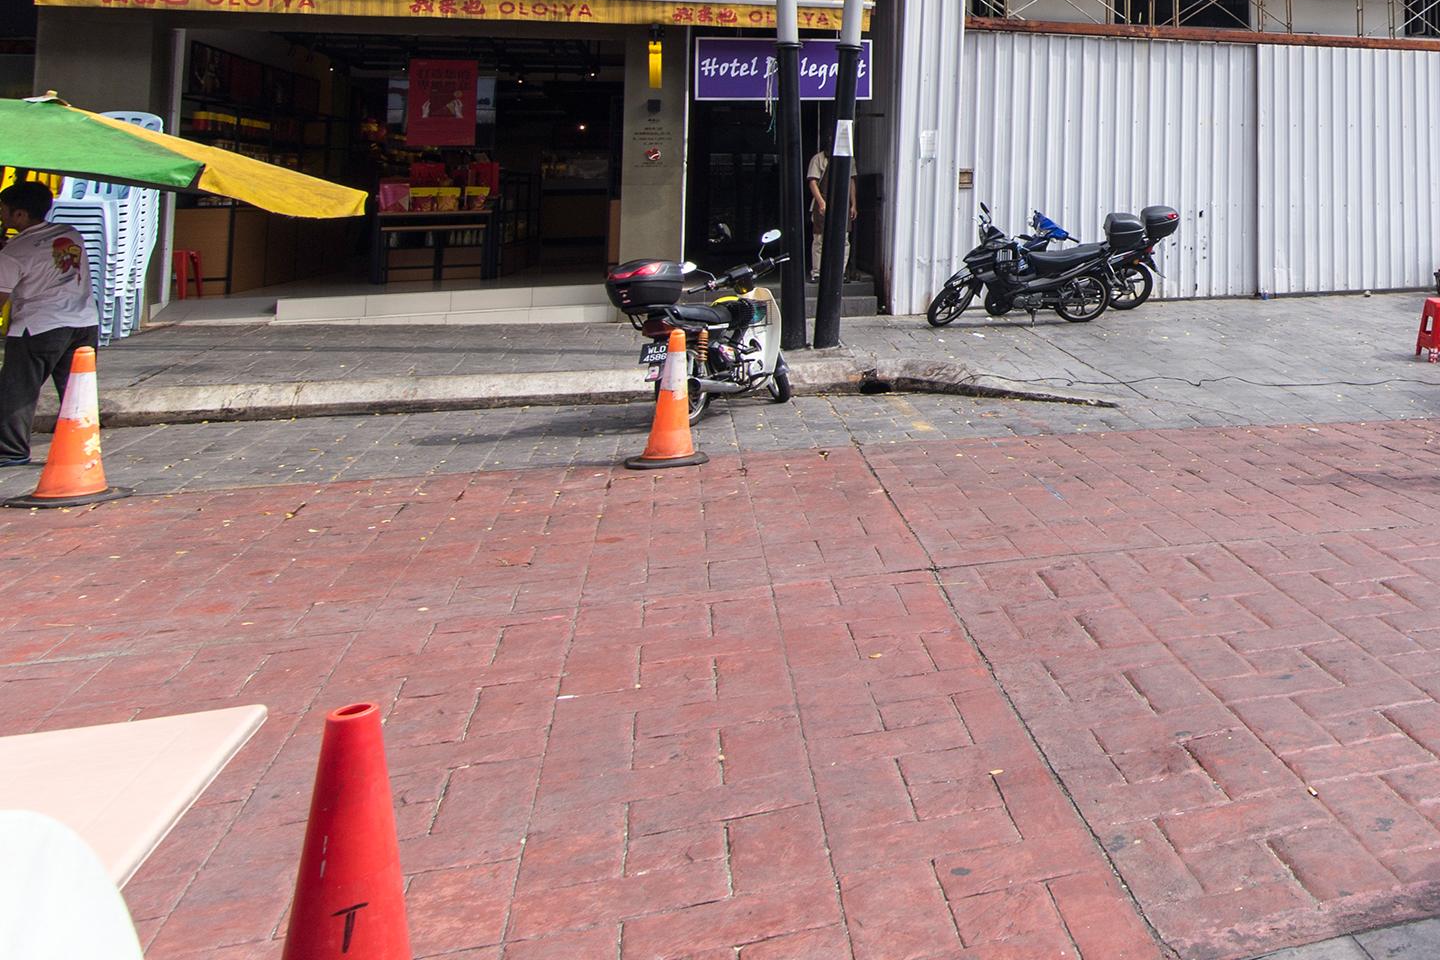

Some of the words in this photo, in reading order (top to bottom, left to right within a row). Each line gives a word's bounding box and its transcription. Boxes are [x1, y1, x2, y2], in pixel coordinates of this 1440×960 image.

[498, 0, 593, 18] OLOIYA
[748, 9, 829, 26] OLYA
[701, 56, 758, 77] Hotel
[647, 344, 667, 354] WLD
[331, 901, 369, 954] T
